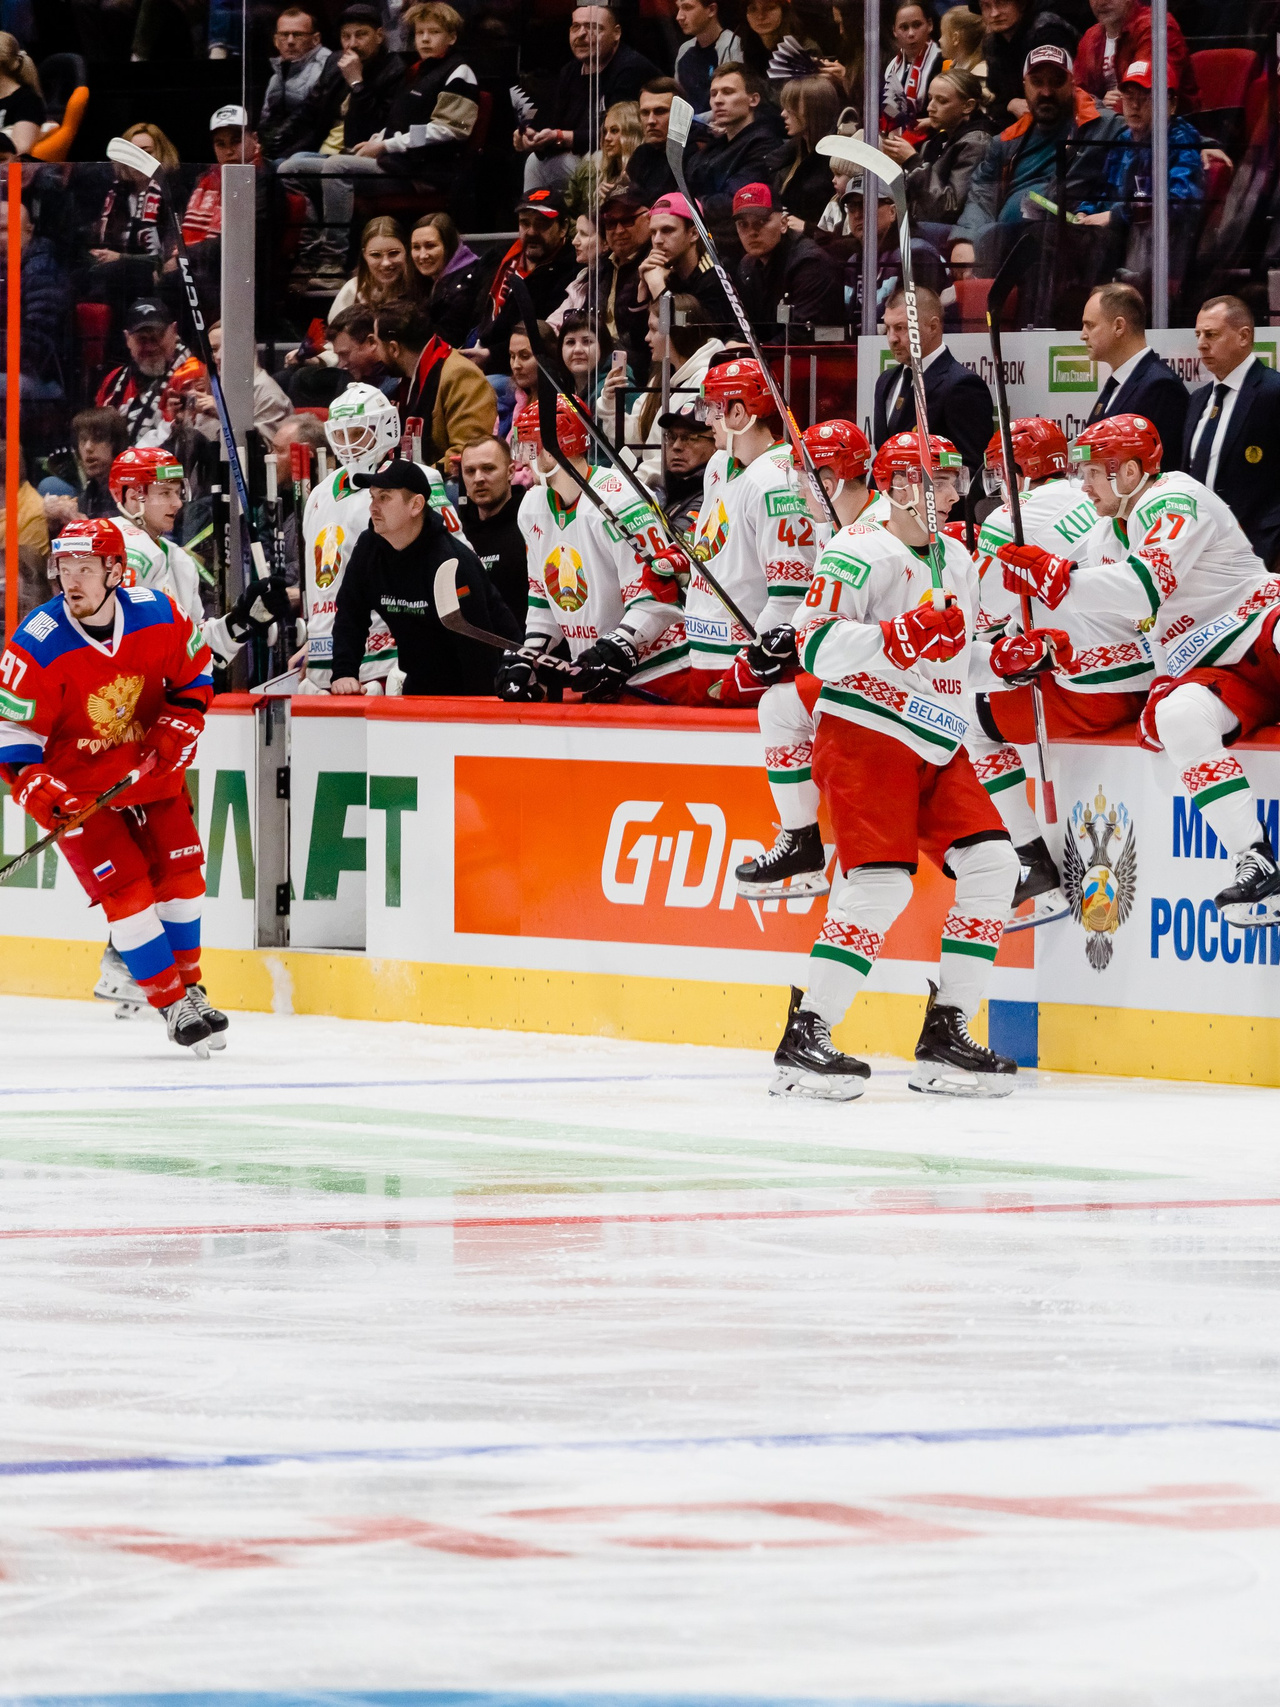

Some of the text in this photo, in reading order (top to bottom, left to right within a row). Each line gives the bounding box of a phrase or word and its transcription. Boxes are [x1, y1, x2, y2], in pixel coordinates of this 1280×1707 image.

[179, 257, 205, 331] CCM
[714, 264, 751, 333] СОЮЗ
[903, 292, 923, 360] СОЮЗ
[980, 356, 1025, 385] СТВОК
[723, 388, 742, 397] CCM
[814, 451, 834, 459] CCM
[1052, 456, 1066, 469] 71
[924, 491, 939, 534] СОЮЗ
[1053, 500, 1098, 544] KUZ
[777, 517, 815, 548] 42
[827, 562, 857, 584] СТАВОК
[806, 576, 842, 612] 81
[685, 619, 728, 638] RUSKALI
[1161, 614, 1195, 645] ARUS
[516, 645, 582, 678] CCM
[603, 631, 638, 669] AUER
[1167, 616, 1235, 676] BELARUSKALI
[0, 649, 28, 691] 97
[932, 678, 963, 695] ARUS
[157, 715, 200, 738] CCM
[169, 844, 201, 860] CCM
